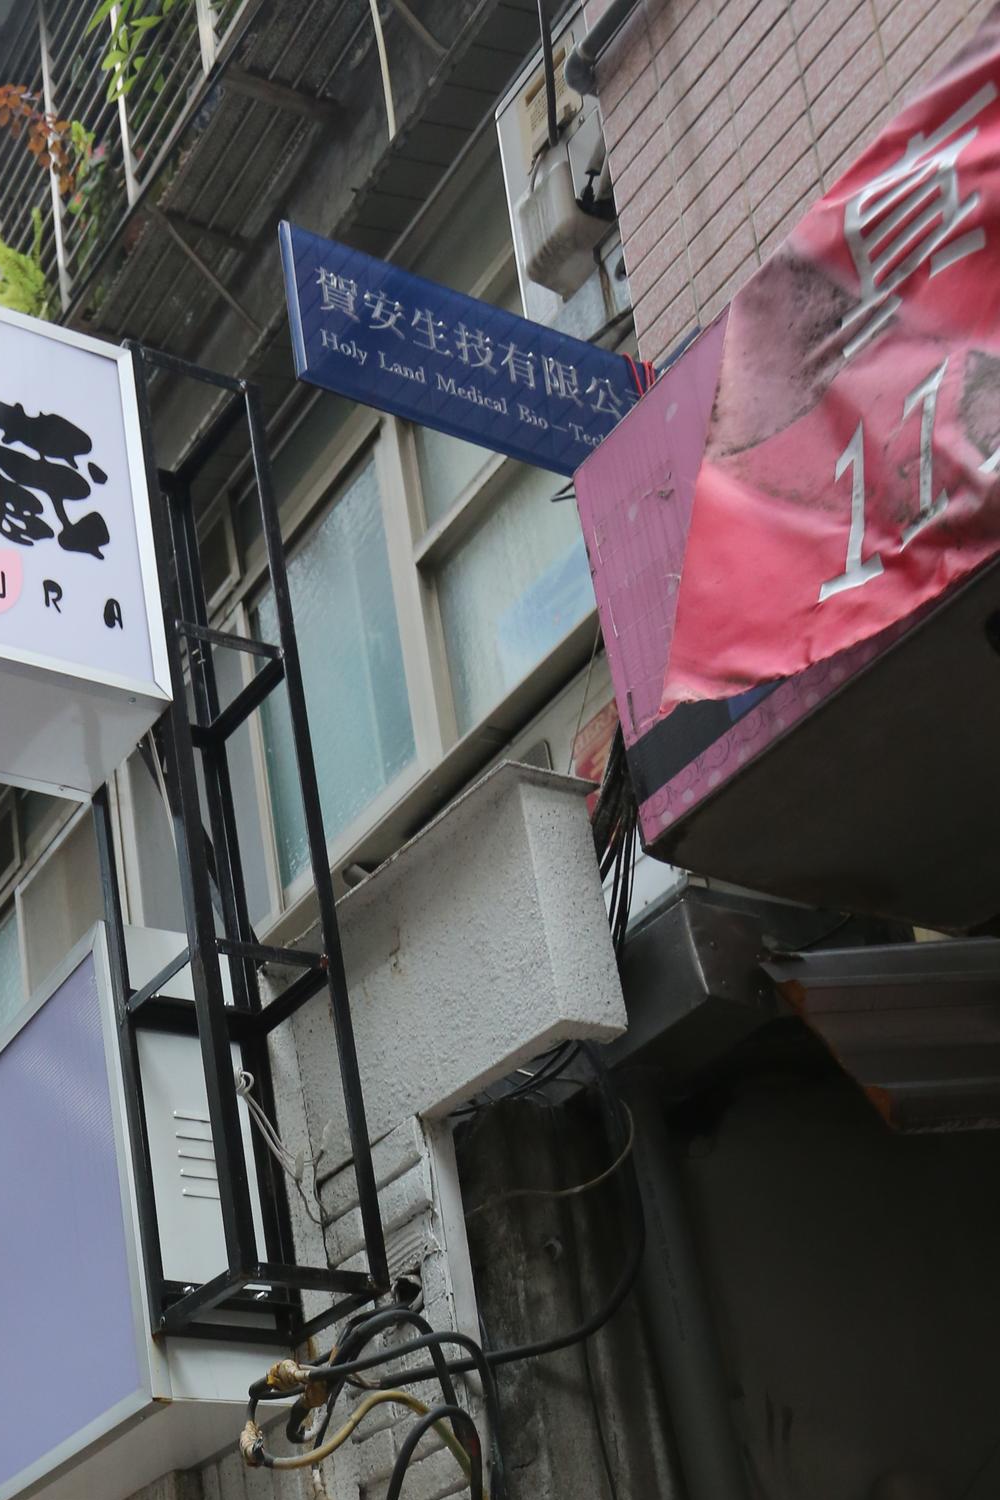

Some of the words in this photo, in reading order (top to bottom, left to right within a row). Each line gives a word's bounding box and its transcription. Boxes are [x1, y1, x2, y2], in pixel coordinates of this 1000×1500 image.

[320, 328, 368, 366] Holy
[379, 351, 425, 384] Land
[436, 373, 508, 415] Medical
